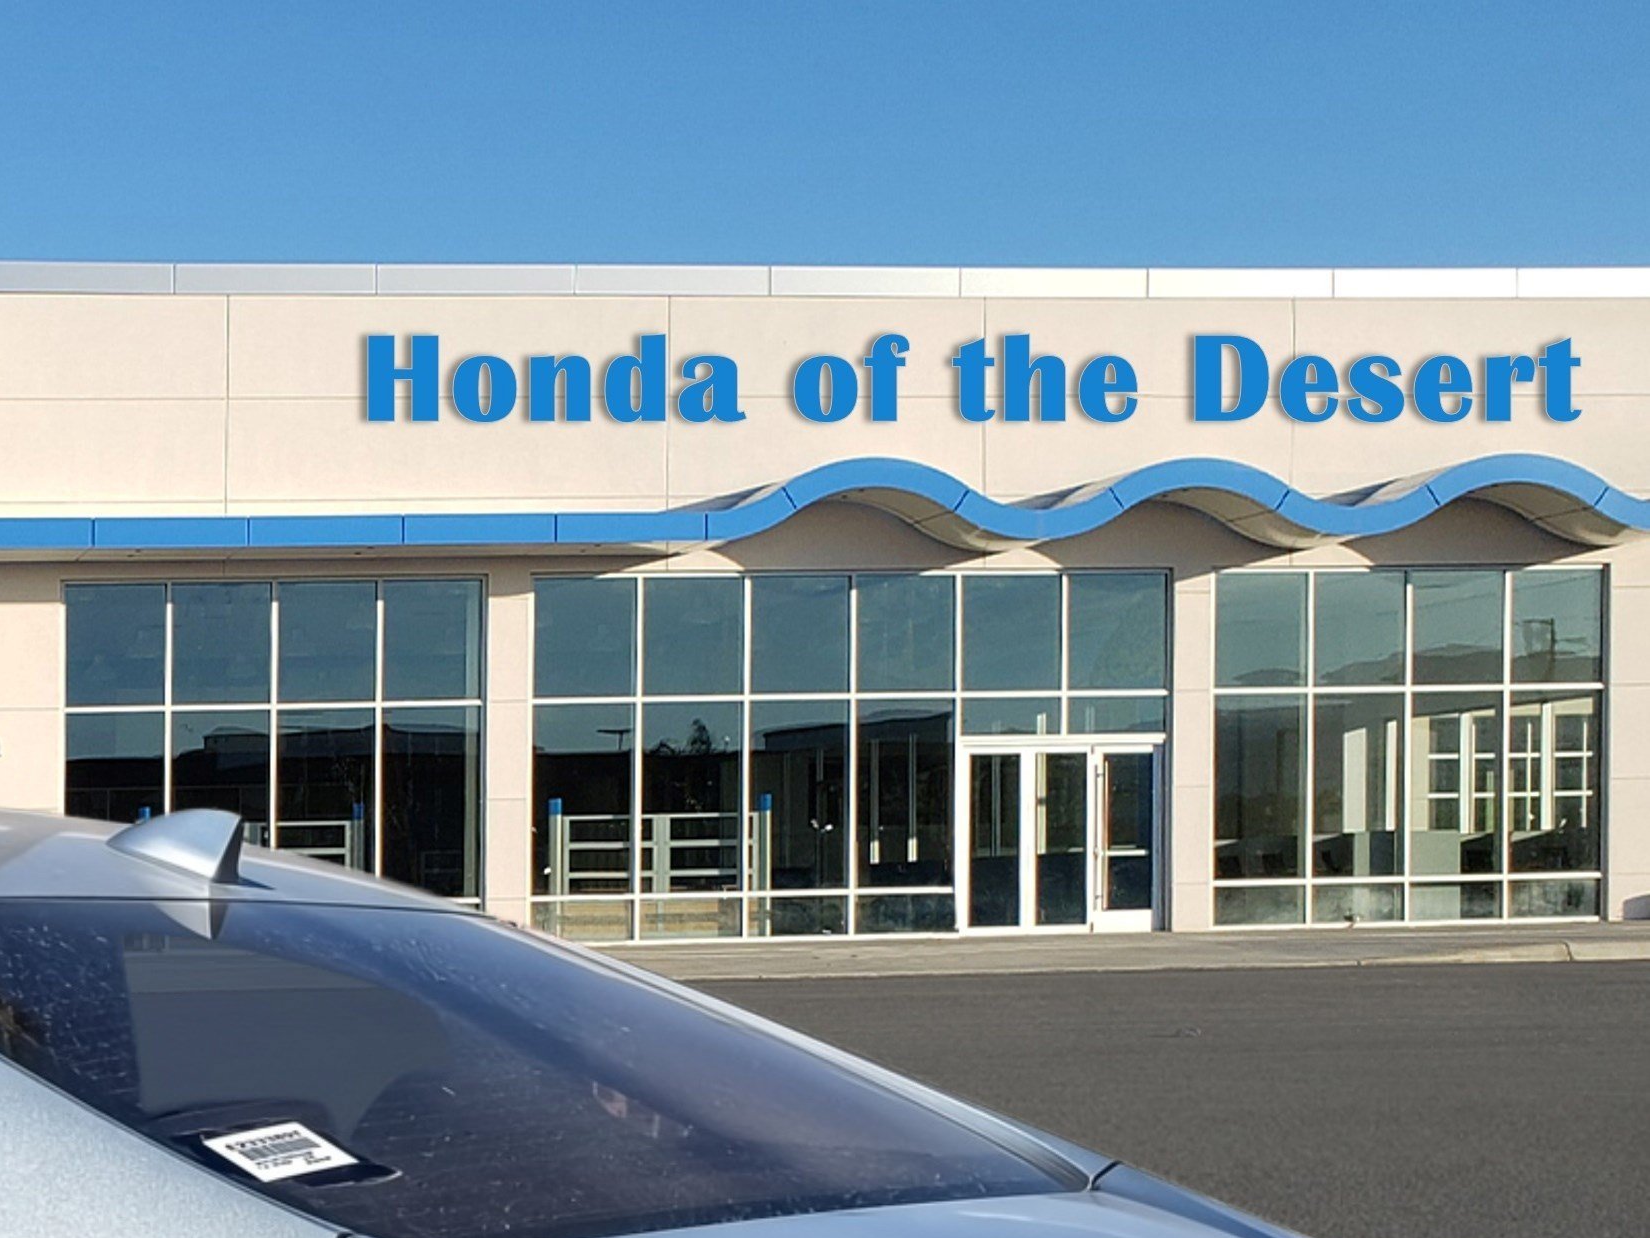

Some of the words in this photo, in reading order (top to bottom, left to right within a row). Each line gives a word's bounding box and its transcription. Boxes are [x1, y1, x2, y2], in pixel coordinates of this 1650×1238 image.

[368, 334, 745, 422] Honda
[794, 334, 909, 423] of
[953, 334, 1137, 422] the
[1195, 335, 1580, 423] Desert
